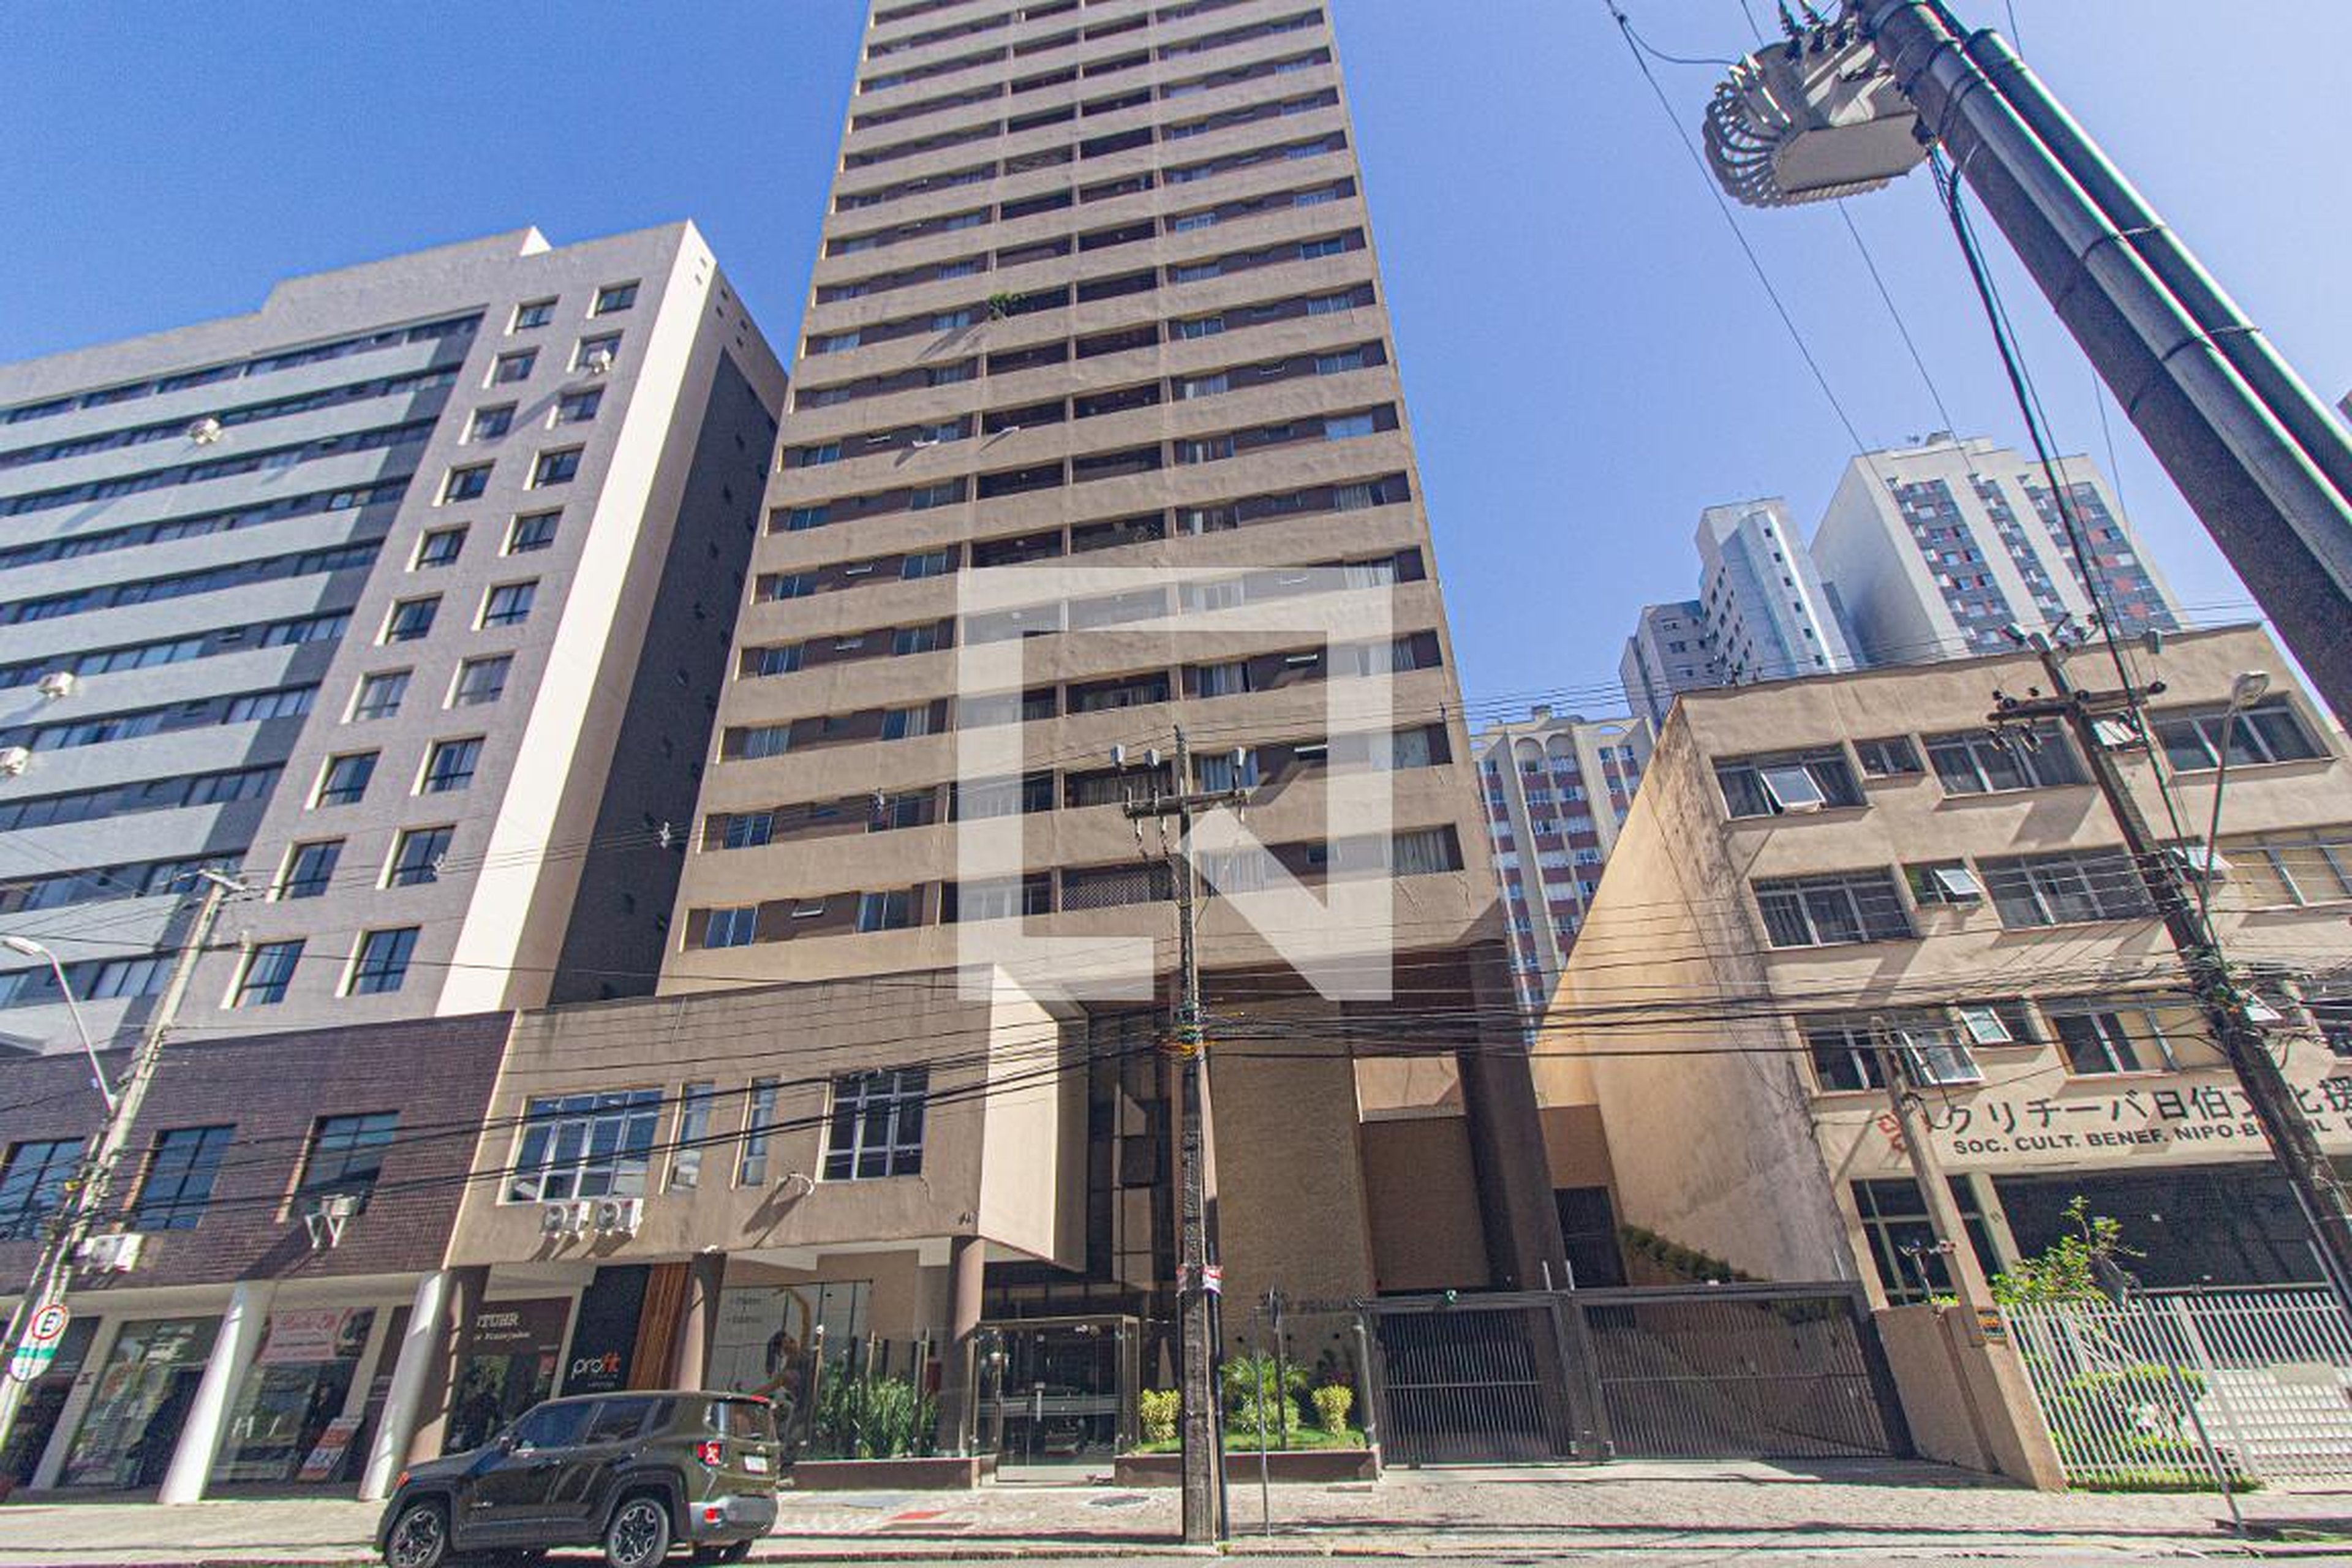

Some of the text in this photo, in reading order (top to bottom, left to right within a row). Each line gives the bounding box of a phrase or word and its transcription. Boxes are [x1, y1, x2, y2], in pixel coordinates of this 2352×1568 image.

[1953, 1138, 2009, 1155] SOC.
[2015, 1134, 2080, 1152] CULT.
[2085, 1128, 2169, 1146] BENEF.
[40, 1311, 58, 1332] E
[571, 1352, 621, 1381] profit
